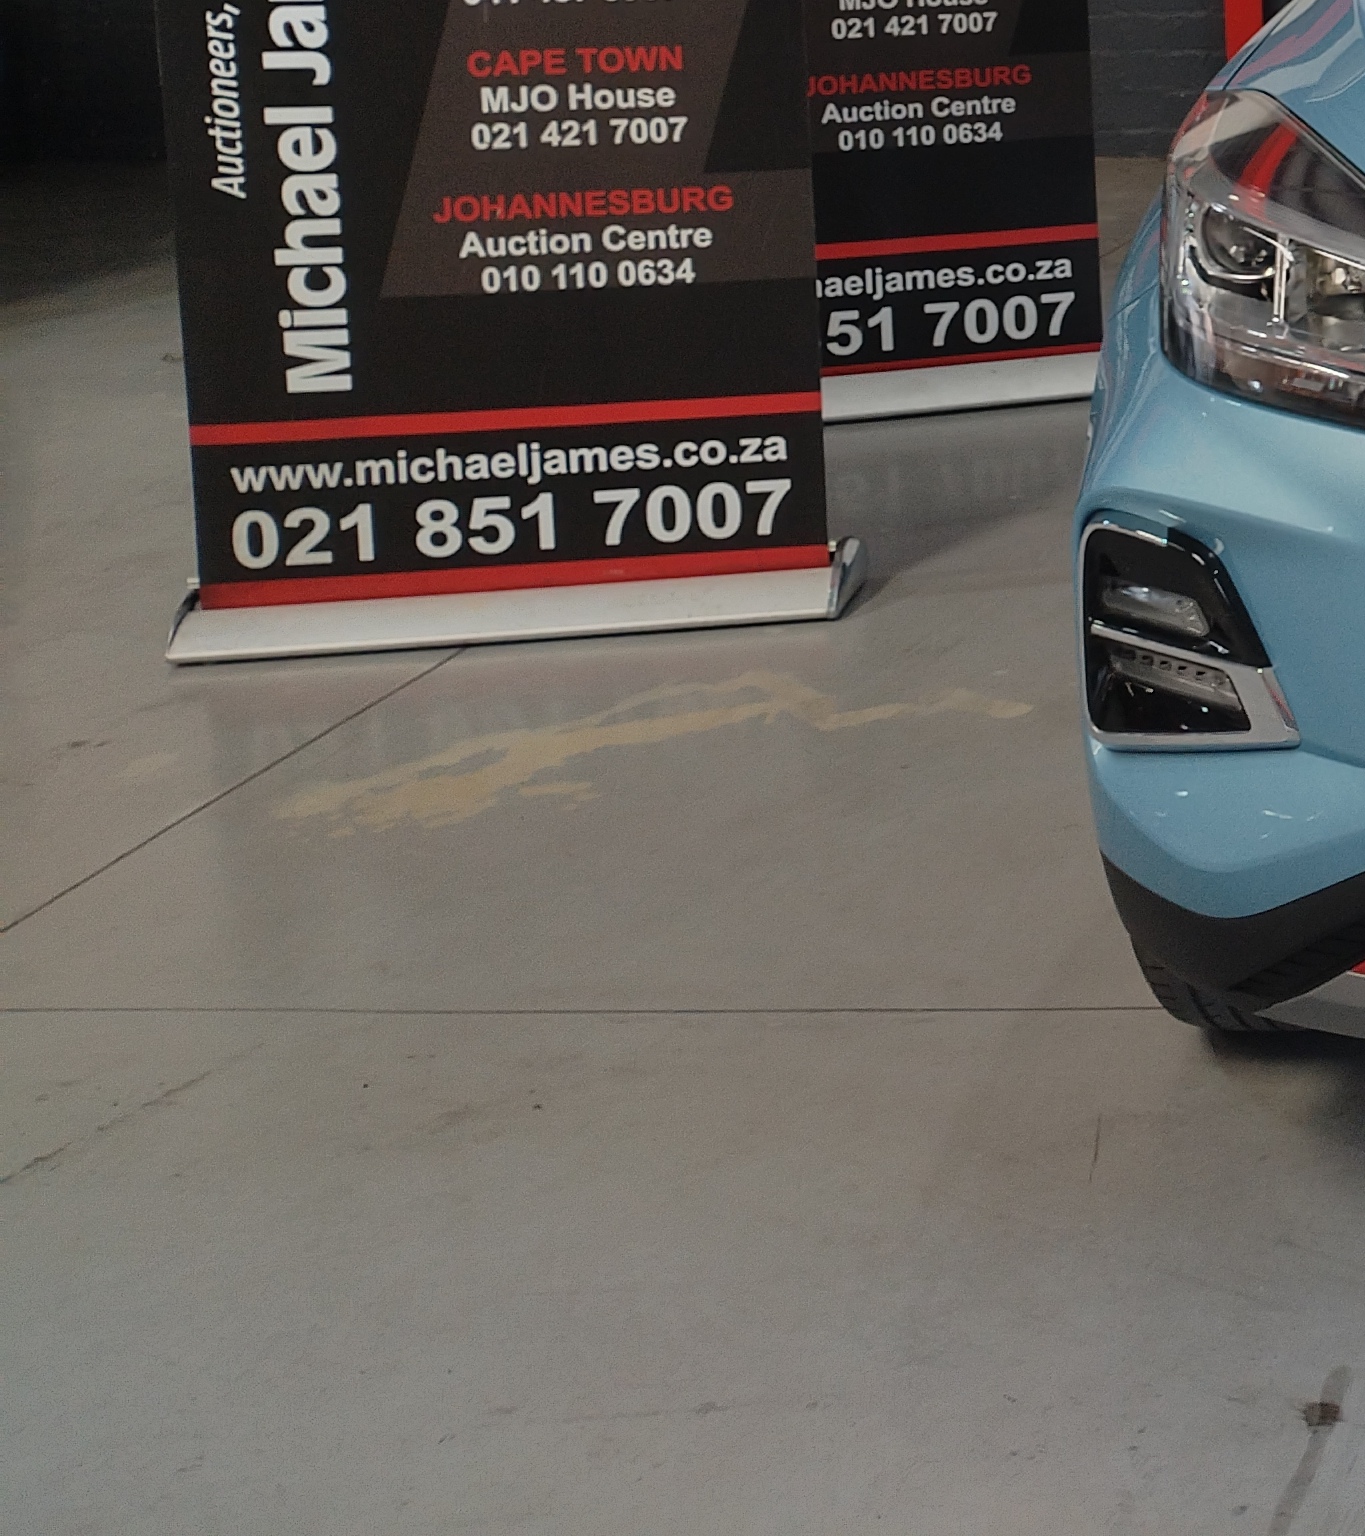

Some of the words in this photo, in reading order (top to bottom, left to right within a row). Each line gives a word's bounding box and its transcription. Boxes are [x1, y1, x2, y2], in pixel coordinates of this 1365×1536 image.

[831, 16, 875, 40] 021
[884, 14, 929, 37] 421
[937, 11, 998, 34] 7007
[467, 48, 567, 78] CAPE
[576, 45, 683, 74] TOWN
[480, 84, 559, 114] MJO
[567, 82, 677, 111] House
[806, 63, 1032, 97] JOHANNESBURG
[204, 2, 247, 199] Auctioneers,
[821, 99, 924, 125] Auction
[930, 95, 1016, 118] Centre
[471, 121, 528, 150] 021
[540, 118, 598, 147] 421
[609, 116, 689, 145] 7007
[838, 128, 885, 152] 010
[892, 124, 936, 147] 110
[942, 121, 1004, 145] 0634
[433, 184, 734, 224] JOHANNESBURG
[263, 105, 353, 394] Michael
[458, 228, 593, 259] Auction
[601, 223, 713, 252] Centre
[481, 264, 541, 294] 010
[551, 261, 609, 290] 110
[617, 257, 696, 287] 0634
[816, 257, 1072, 301] aeljames.co.za
[826, 306, 894, 356] 51
[923, 291, 1076, 347] 7007
[231, 434, 787, 494] www.michaeljames.co.za
[232, 503, 375, 569] 021
[415, 491, 556, 558] 851
[593, 478, 792, 546] 7007
